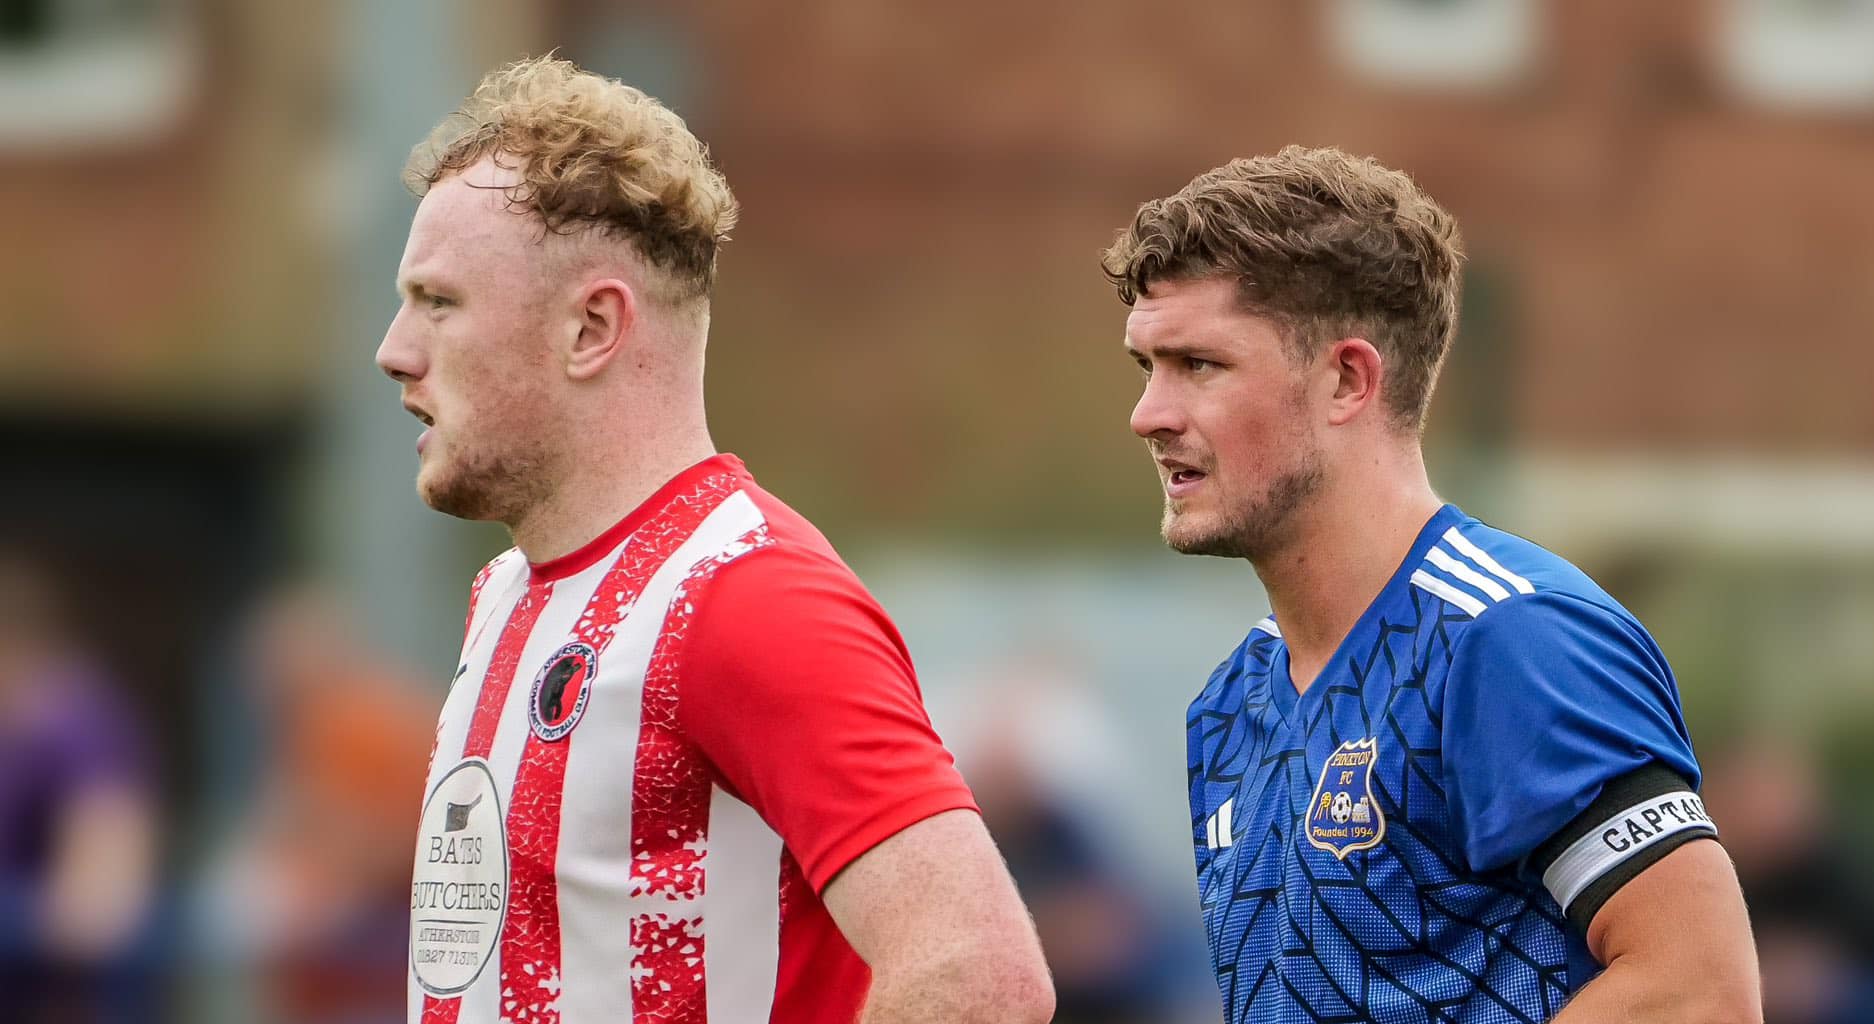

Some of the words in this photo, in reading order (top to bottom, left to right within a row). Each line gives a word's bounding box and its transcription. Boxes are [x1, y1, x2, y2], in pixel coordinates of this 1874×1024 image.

[1339, 771, 1354, 785] FC
[1313, 826, 1348, 838] Founded
[1351, 828, 1374, 838] 1994
[427, 836, 482, 865] BATES
